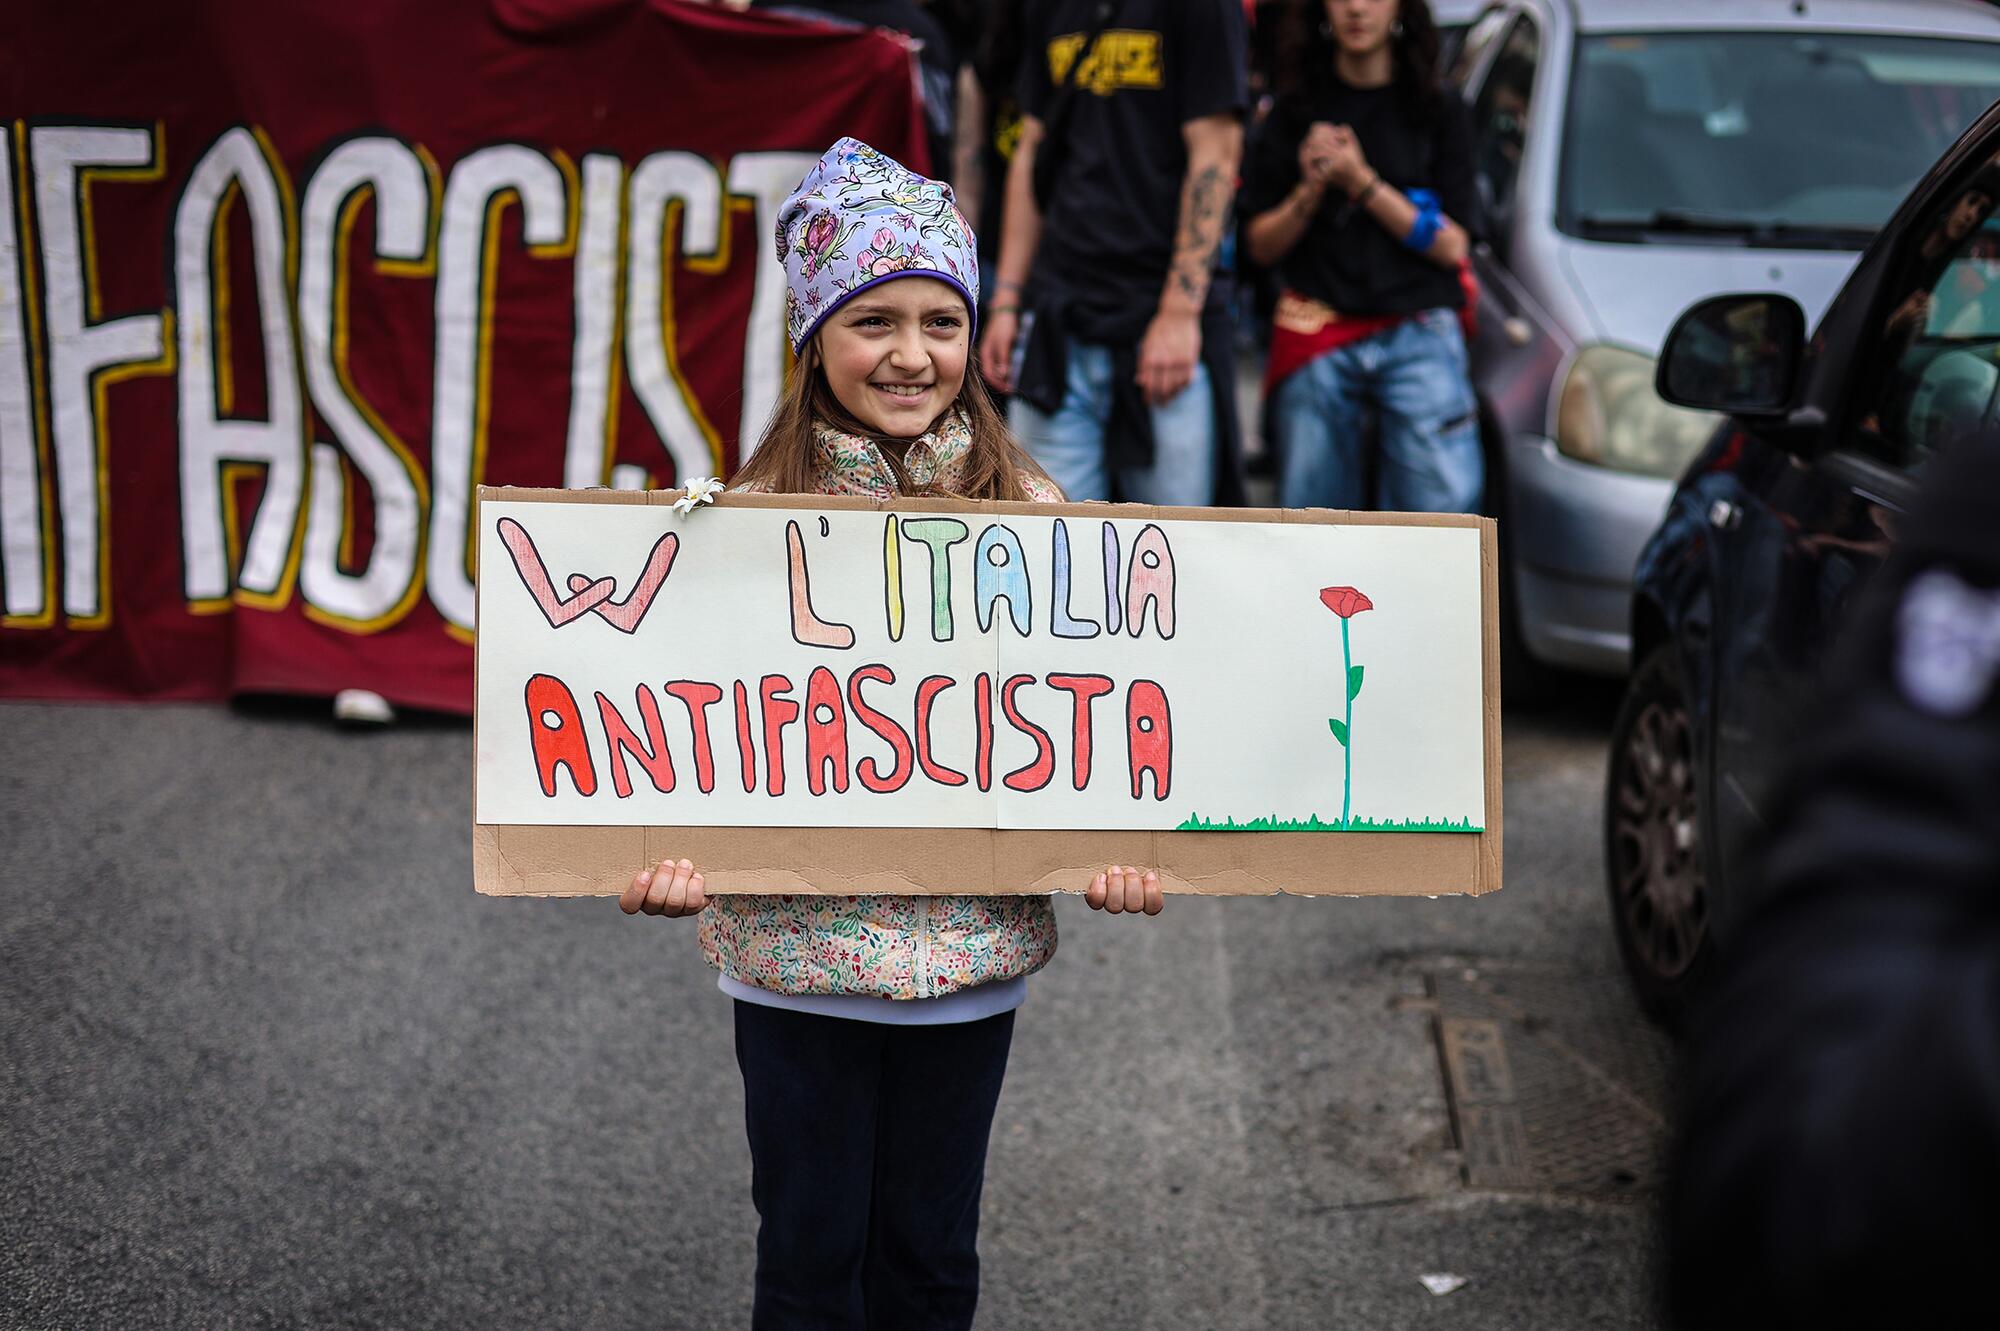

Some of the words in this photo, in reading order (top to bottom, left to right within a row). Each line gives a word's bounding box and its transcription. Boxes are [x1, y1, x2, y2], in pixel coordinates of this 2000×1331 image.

[496, 516, 681, 635] W
[785, 513, 1177, 650] L'ITALIA
[524, 663, 1173, 801] ANTIFASCISTA
